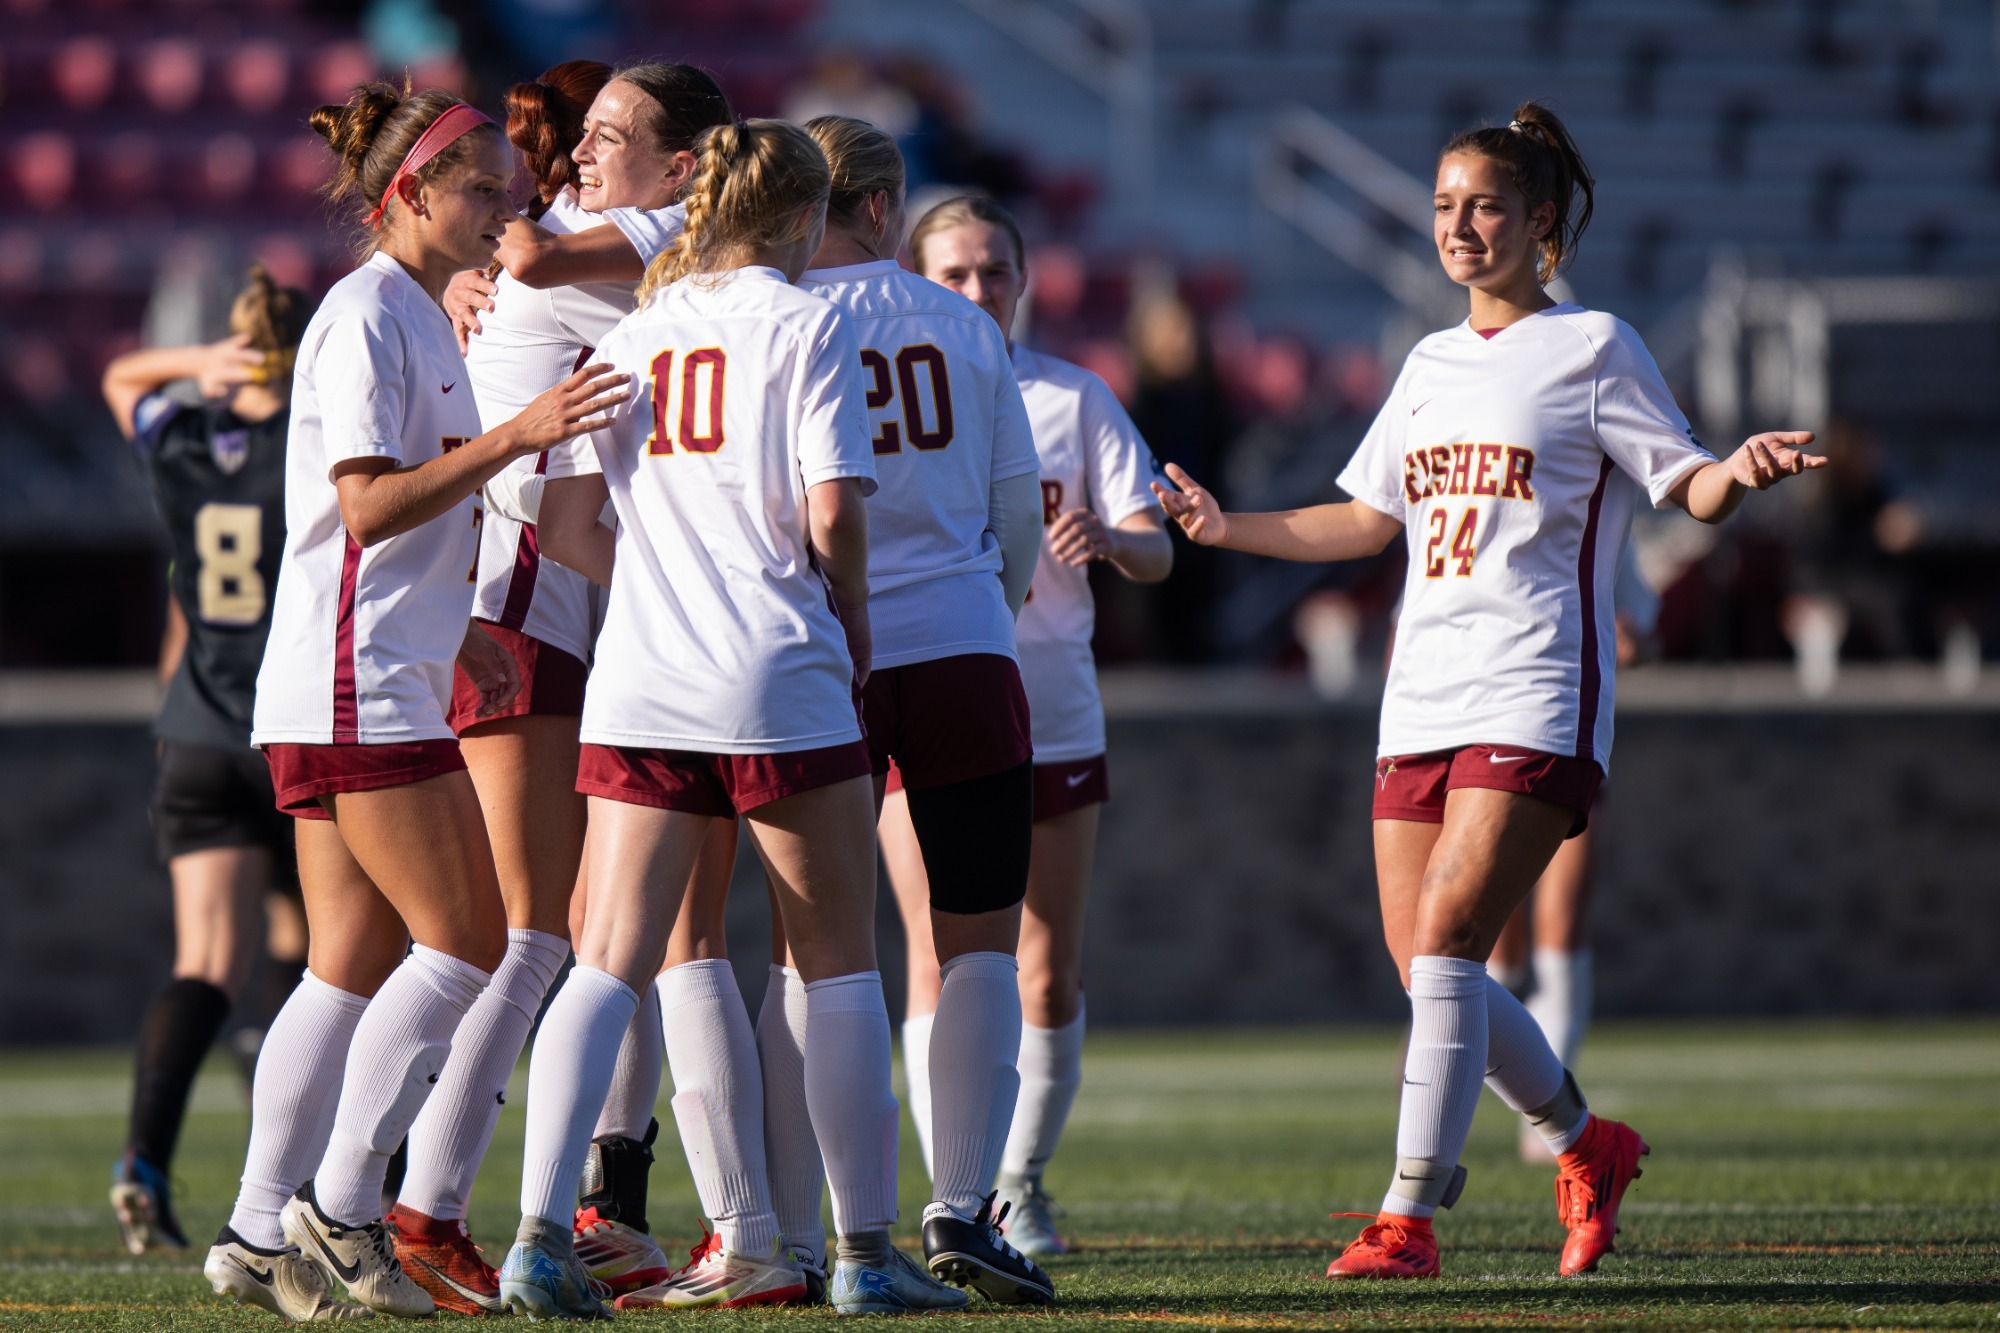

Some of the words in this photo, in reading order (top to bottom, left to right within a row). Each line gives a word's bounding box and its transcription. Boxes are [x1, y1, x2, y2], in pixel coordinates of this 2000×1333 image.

[648, 347, 727, 456] 10
[860, 343, 954, 456] 20
[1404, 443, 1535, 506] FISHER
[195, 503, 266, 625] 8
[1425, 505, 1479, 578] 24
